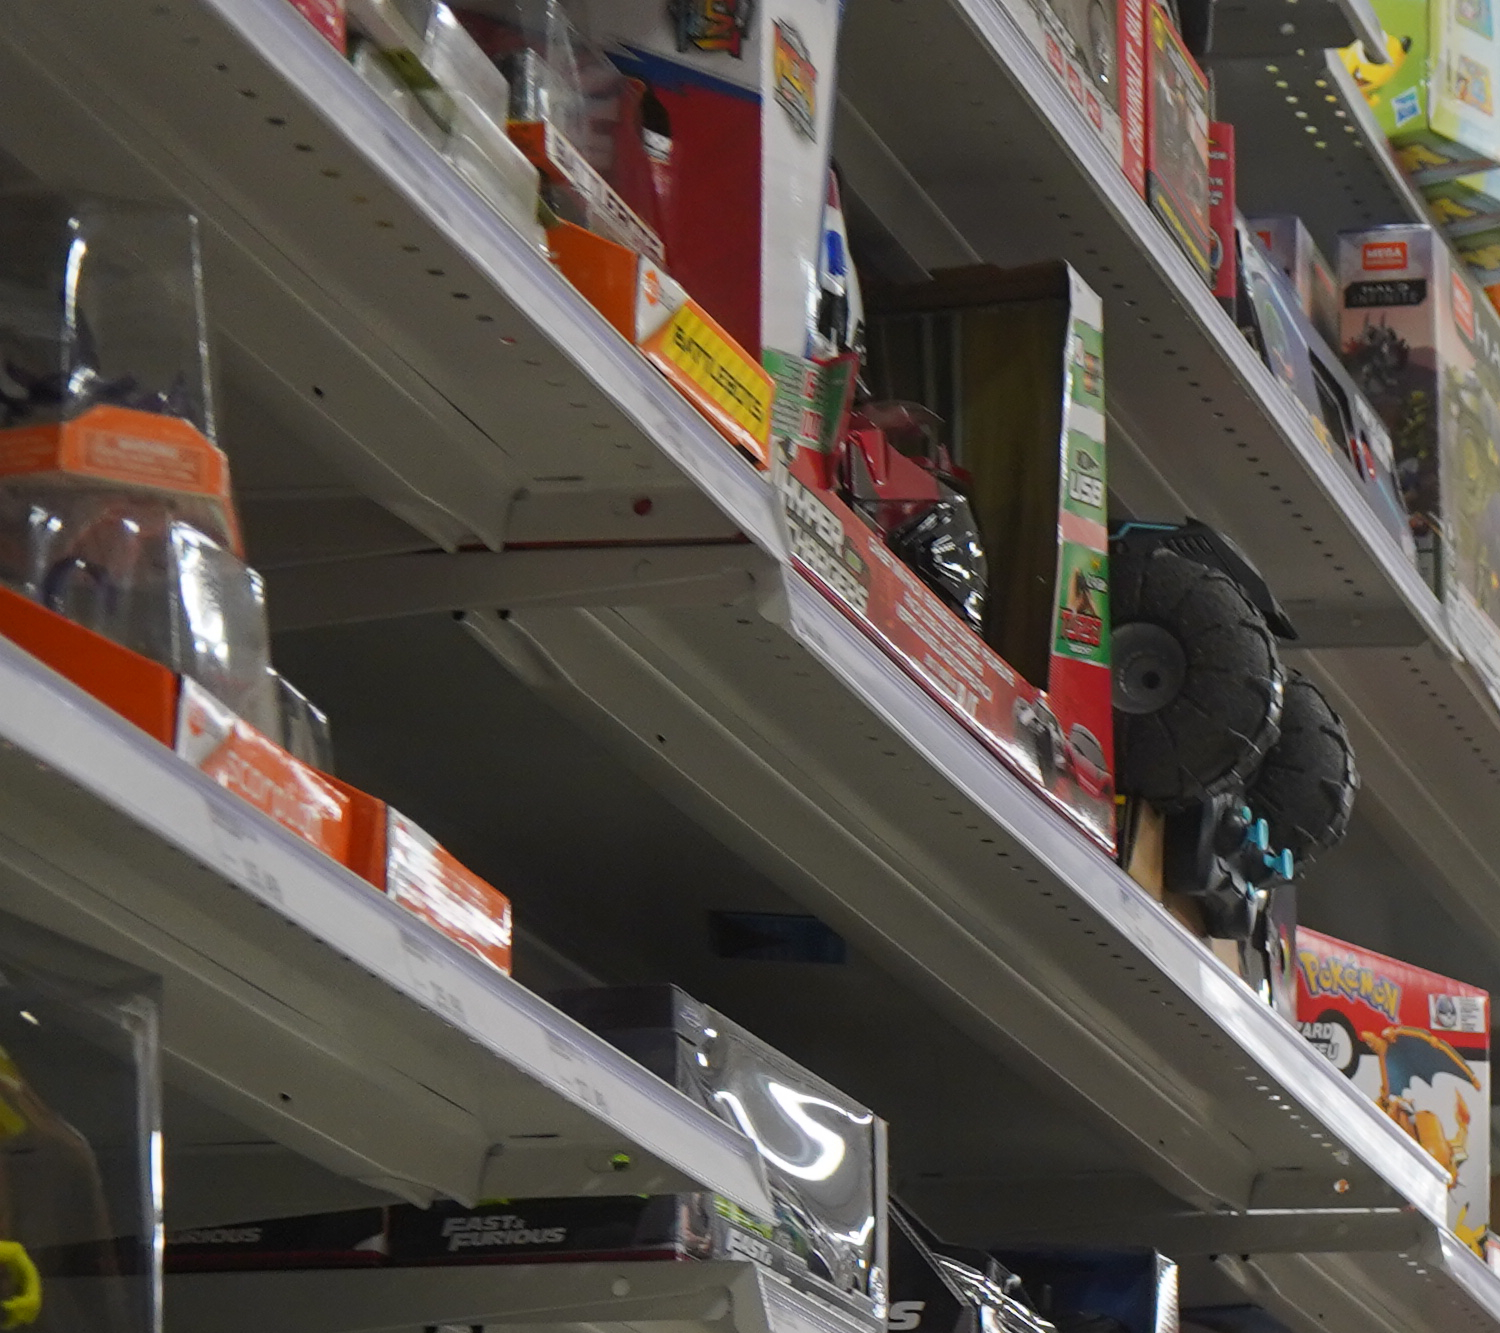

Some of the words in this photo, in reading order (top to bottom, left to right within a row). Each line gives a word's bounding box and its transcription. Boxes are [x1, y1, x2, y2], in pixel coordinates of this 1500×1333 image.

[1125, 40, 1145, 156] CHEVROLET
[1366, 246, 1403, 260] MEGA
[670, 321, 765, 424] BATTLEBOTS
[1069, 476, 1103, 508] USB
[449, 1225, 566, 1252] FURIOUS
